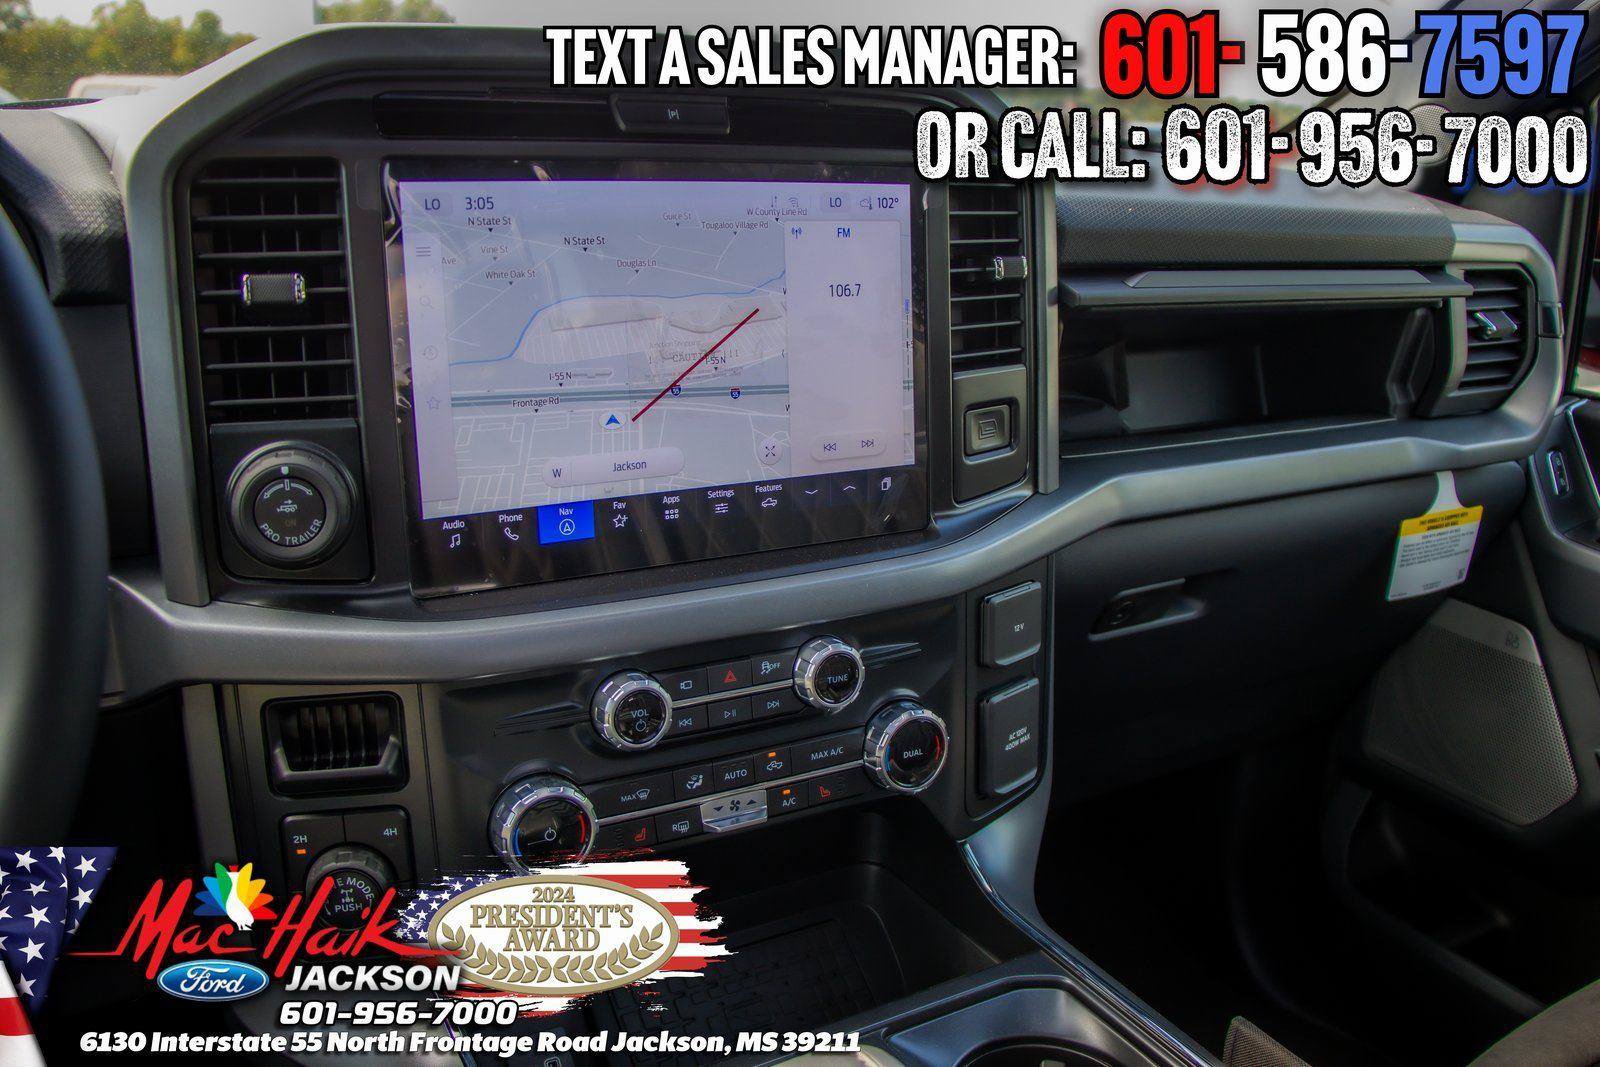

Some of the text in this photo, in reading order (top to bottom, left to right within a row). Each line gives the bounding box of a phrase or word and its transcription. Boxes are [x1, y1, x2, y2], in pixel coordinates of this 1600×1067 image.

[424, 198, 441, 211] LO
[465, 196, 495, 211] 3:05
[829, 197, 842, 208] LO
[877, 197, 899, 209] 102°
[683, 212, 692, 220] St
[746, 208, 808, 218] W County Line Rd
[468, 216, 512, 226] N State St
[701, 221, 769, 232] Tougaloo Village Rd
[837, 227, 851, 238] FM
[564, 236, 606, 246] N State St
[481, 245, 509, 254] Vine St
[441, 257, 456, 265] Ave
[617, 259, 657, 270] Douglas Ln
[485, 269, 536, 280] White Oak St
[828, 284, 861, 298] 106.7
[550, 371, 572, 381] I-55 N
[512, 397, 559, 409] Frontage Rd
[612, 460, 647, 473] Jackson
[552, 468, 562, 478] W
[707, 487, 735, 500] Settings
[755, 483, 783, 493] Features
[613, 501, 627, 510] Fav
[662, 495, 680, 505] Apps
[559, 507, 574, 516] Nav
[499, 512, 523, 524] Phone
[442, 519, 465, 531] Audio
[260, 518, 323, 546] PRO TRAILER
[769, 661, 781, 671] OFF
[827, 673, 849, 684] TUNE
[631, 708, 650, 718] VOL
[811, 746, 844, 760] MAX A/C
[903, 748, 923, 759] DUAL
[724, 769, 748, 781] AUTO
[620, 794, 637, 802] MAX
[782, 798, 796, 807] A/C
[383, 827, 398, 837] 4H
[293, 835, 308, 844] 2H
[346, 876, 375, 900] MODE
[335, 903, 363, 913] PUSH
